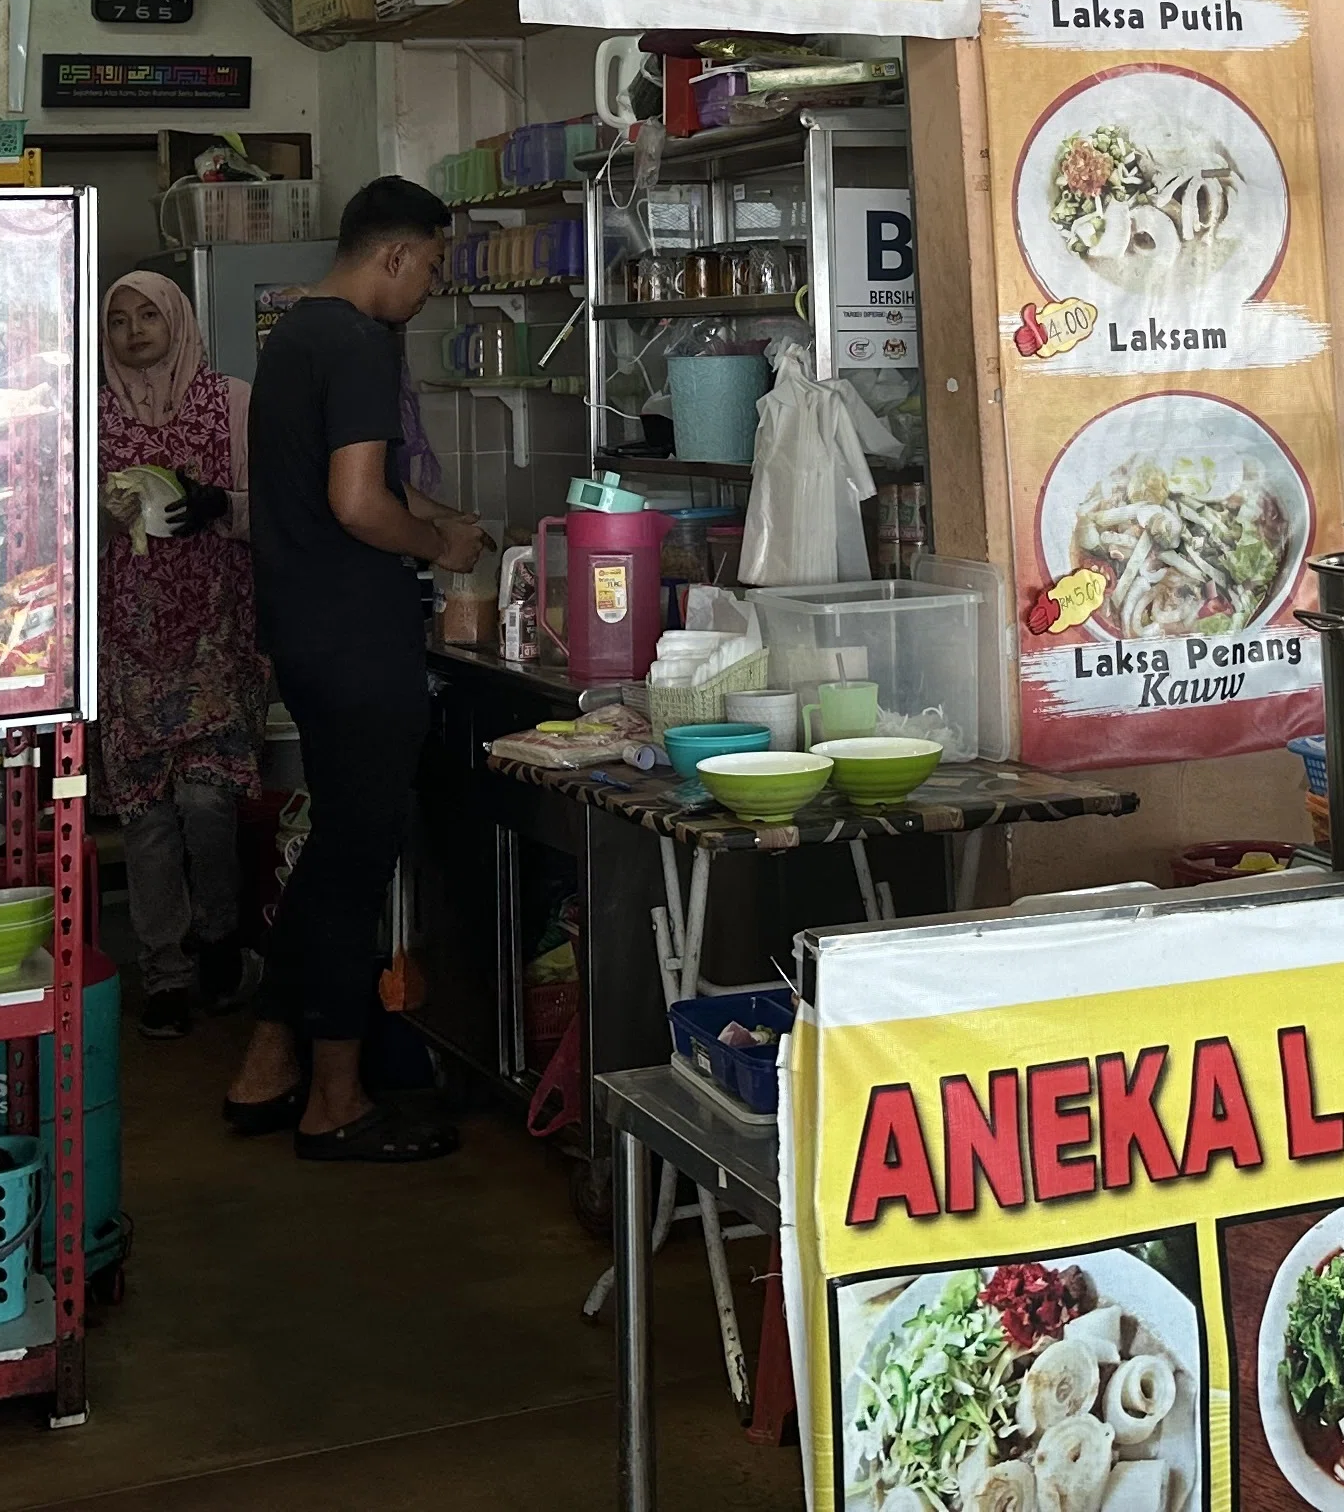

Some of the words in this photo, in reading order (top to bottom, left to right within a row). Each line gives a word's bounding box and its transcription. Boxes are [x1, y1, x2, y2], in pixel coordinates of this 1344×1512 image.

[1160, 0, 1243, 31] Putih
[867, 210, 914, 281] B
[870, 291, 914, 304] BERSIH
[1108, 318, 1227, 352] Laksam
[1074, 642, 1168, 680] Laksa
[1187, 636, 1302, 671] Penang
[1138, 671, 1245, 709] Kaww
[846, 1036, 1262, 1227] ANEKA
